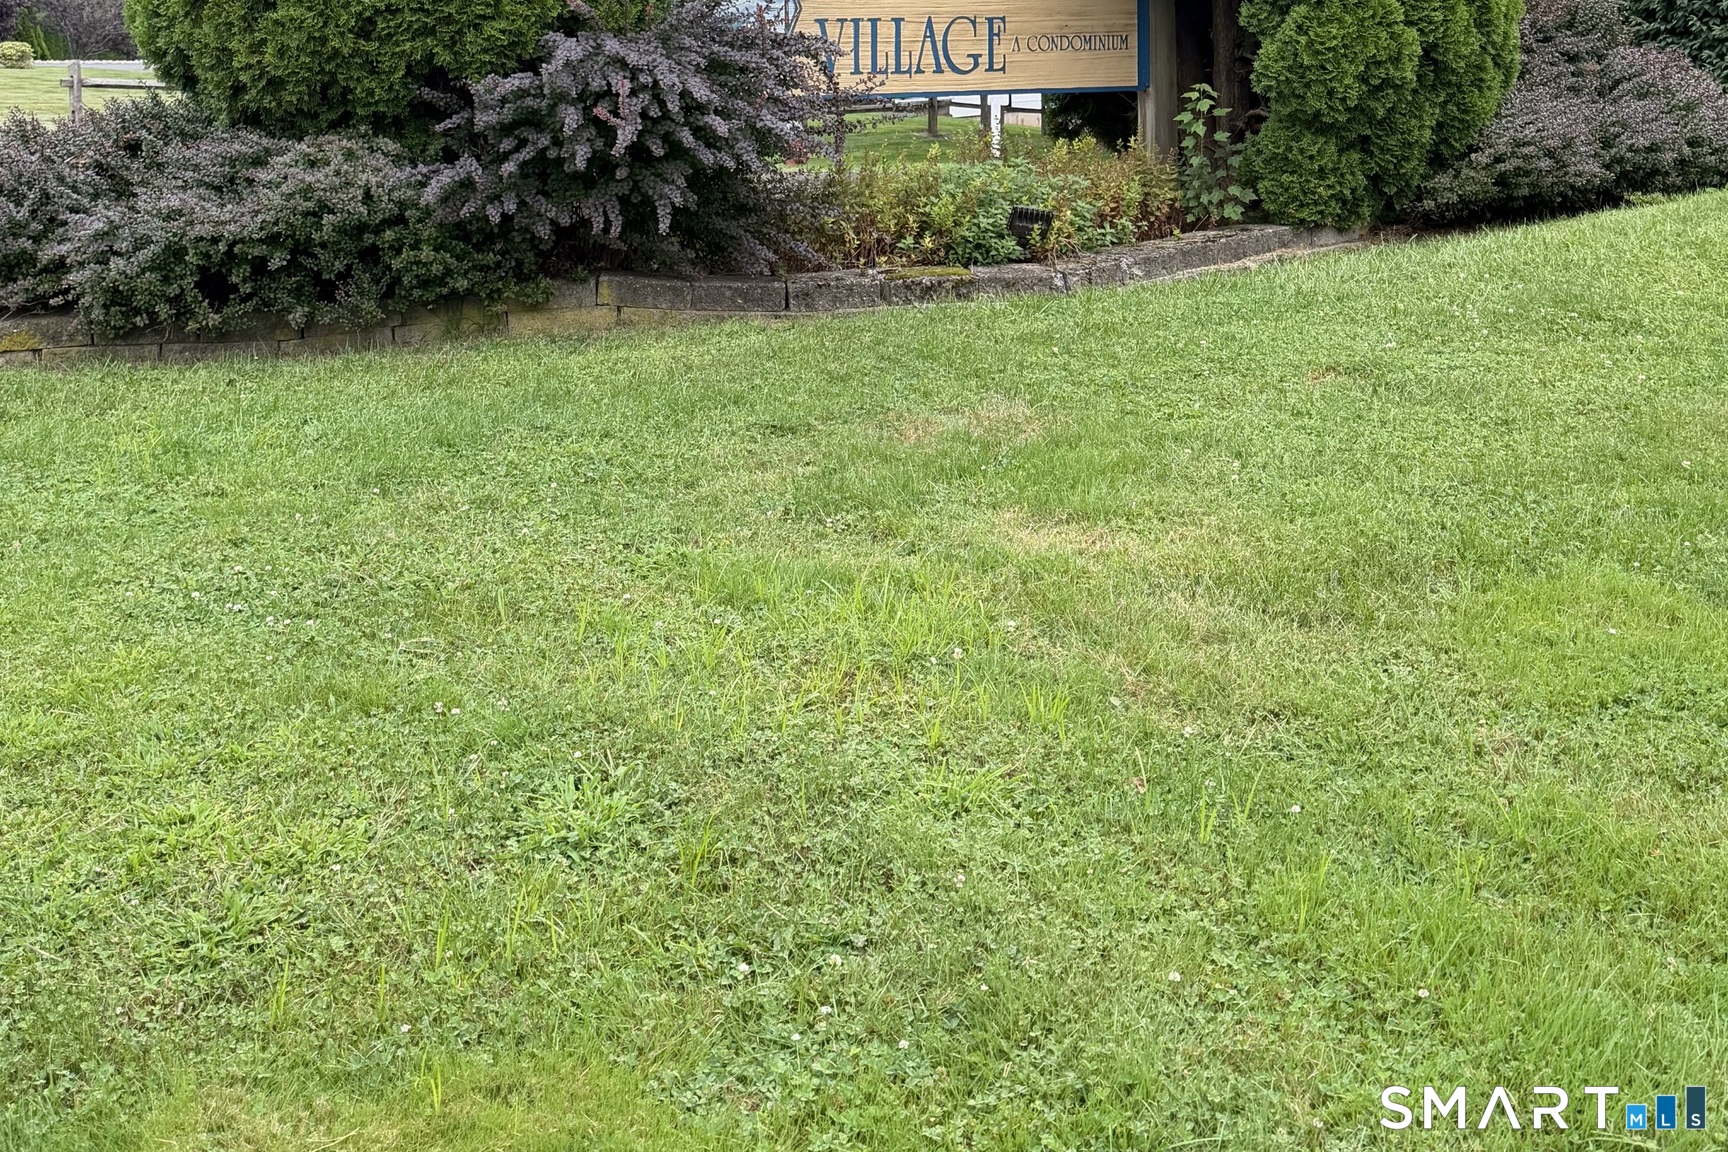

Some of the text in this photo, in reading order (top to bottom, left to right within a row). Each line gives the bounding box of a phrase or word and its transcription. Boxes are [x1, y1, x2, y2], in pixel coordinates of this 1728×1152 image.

[813, 15, 1007, 80] VILLAGE
[1011, 34, 1129, 52] A CONDOMINIUM
